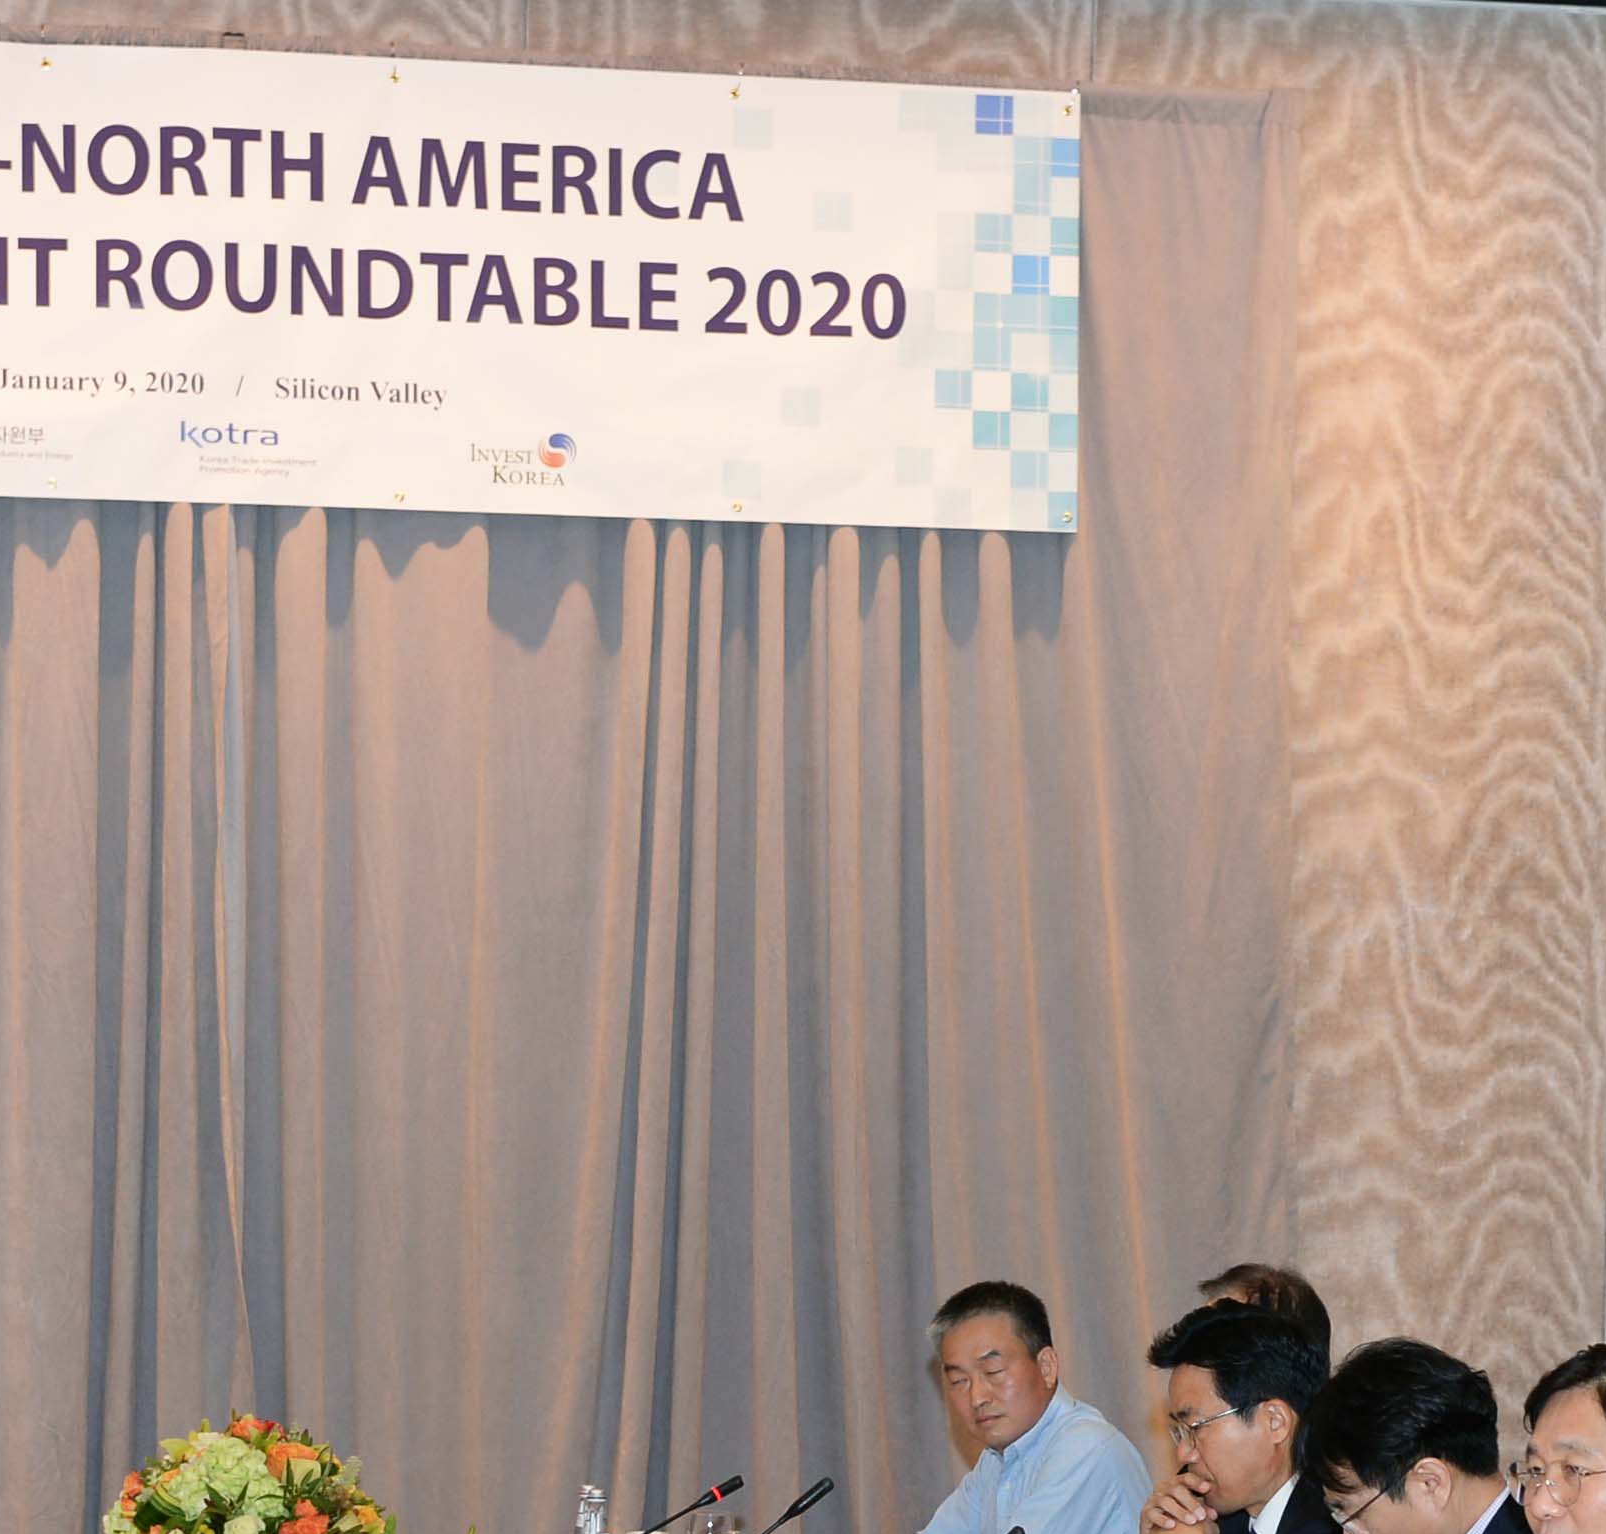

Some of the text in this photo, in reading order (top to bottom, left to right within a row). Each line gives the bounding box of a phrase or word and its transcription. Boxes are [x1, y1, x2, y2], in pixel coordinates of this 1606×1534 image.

[350, 135, 745, 223] AMERICA
[94, 238, 680, 333] ROUNDTABLE
[703, 266, 908, 341] 2020
[113, 371, 136, 398] 9,
[145, 371, 205, 395] 2020
[275, 377, 361, 402] Silicon
[369, 380, 447, 411] Valley
[179, 420, 279, 449] kotra
[470, 442, 535, 465] INVEST
[491, 464, 567, 487] KOREA
